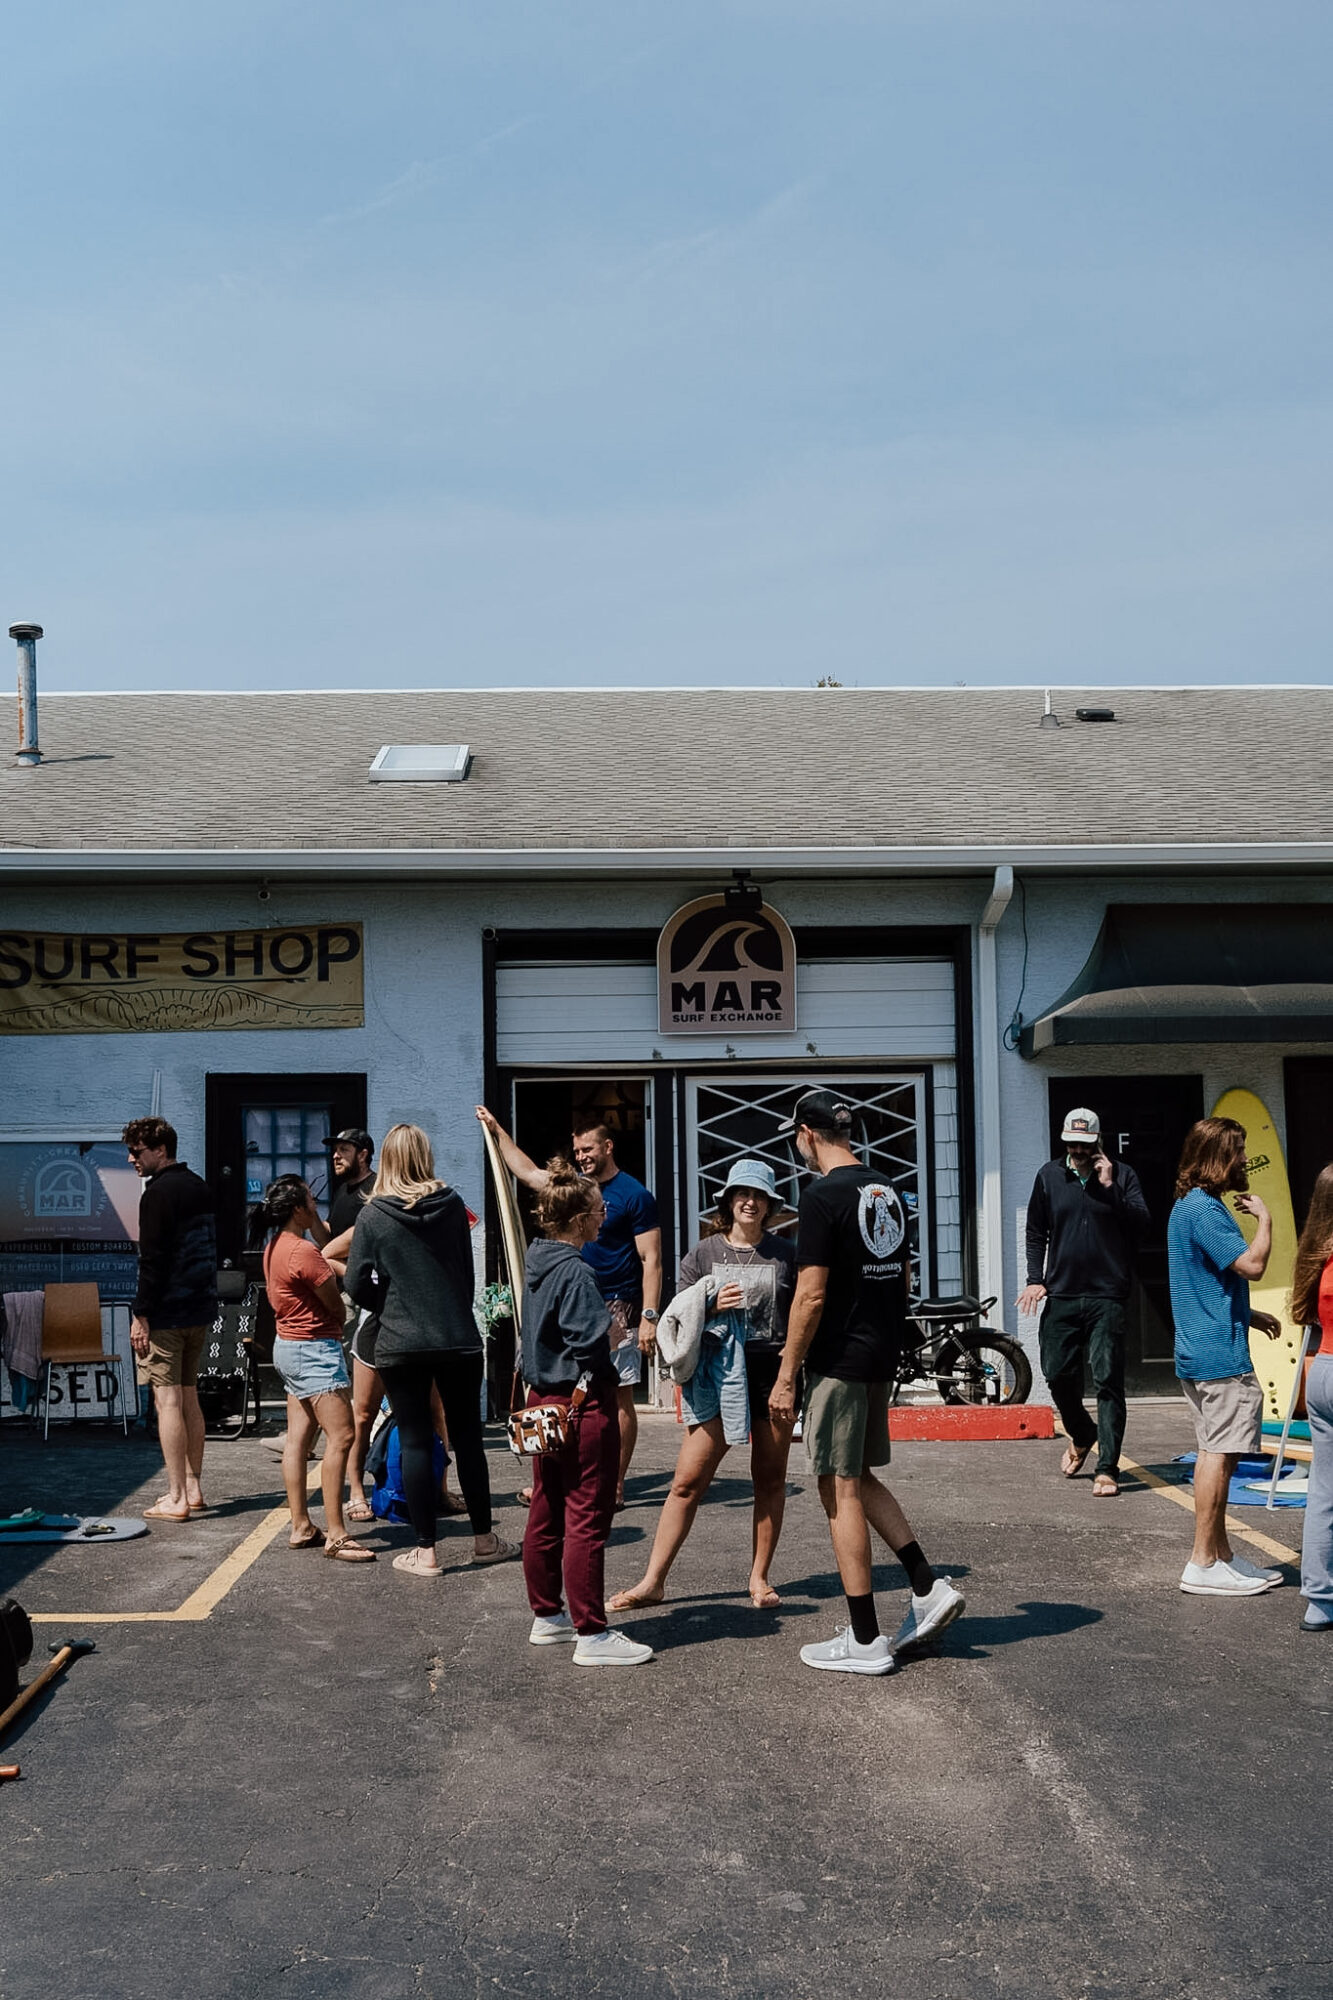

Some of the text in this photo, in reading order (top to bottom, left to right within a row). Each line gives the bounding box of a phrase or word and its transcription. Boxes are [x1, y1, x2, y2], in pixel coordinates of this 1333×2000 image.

[0, 927, 361, 989] SURF SHOP
[671, 981, 783, 1012] MAR
[672, 1012, 782, 1023] SURF EXCHANGE
[1118, 1133, 1130, 1154] F
[40, 1194, 86, 1208] MAR
[72, 1242, 133, 1251] CUSTOM BOARDS
[108, 1282, 136, 1290] FACTOR
